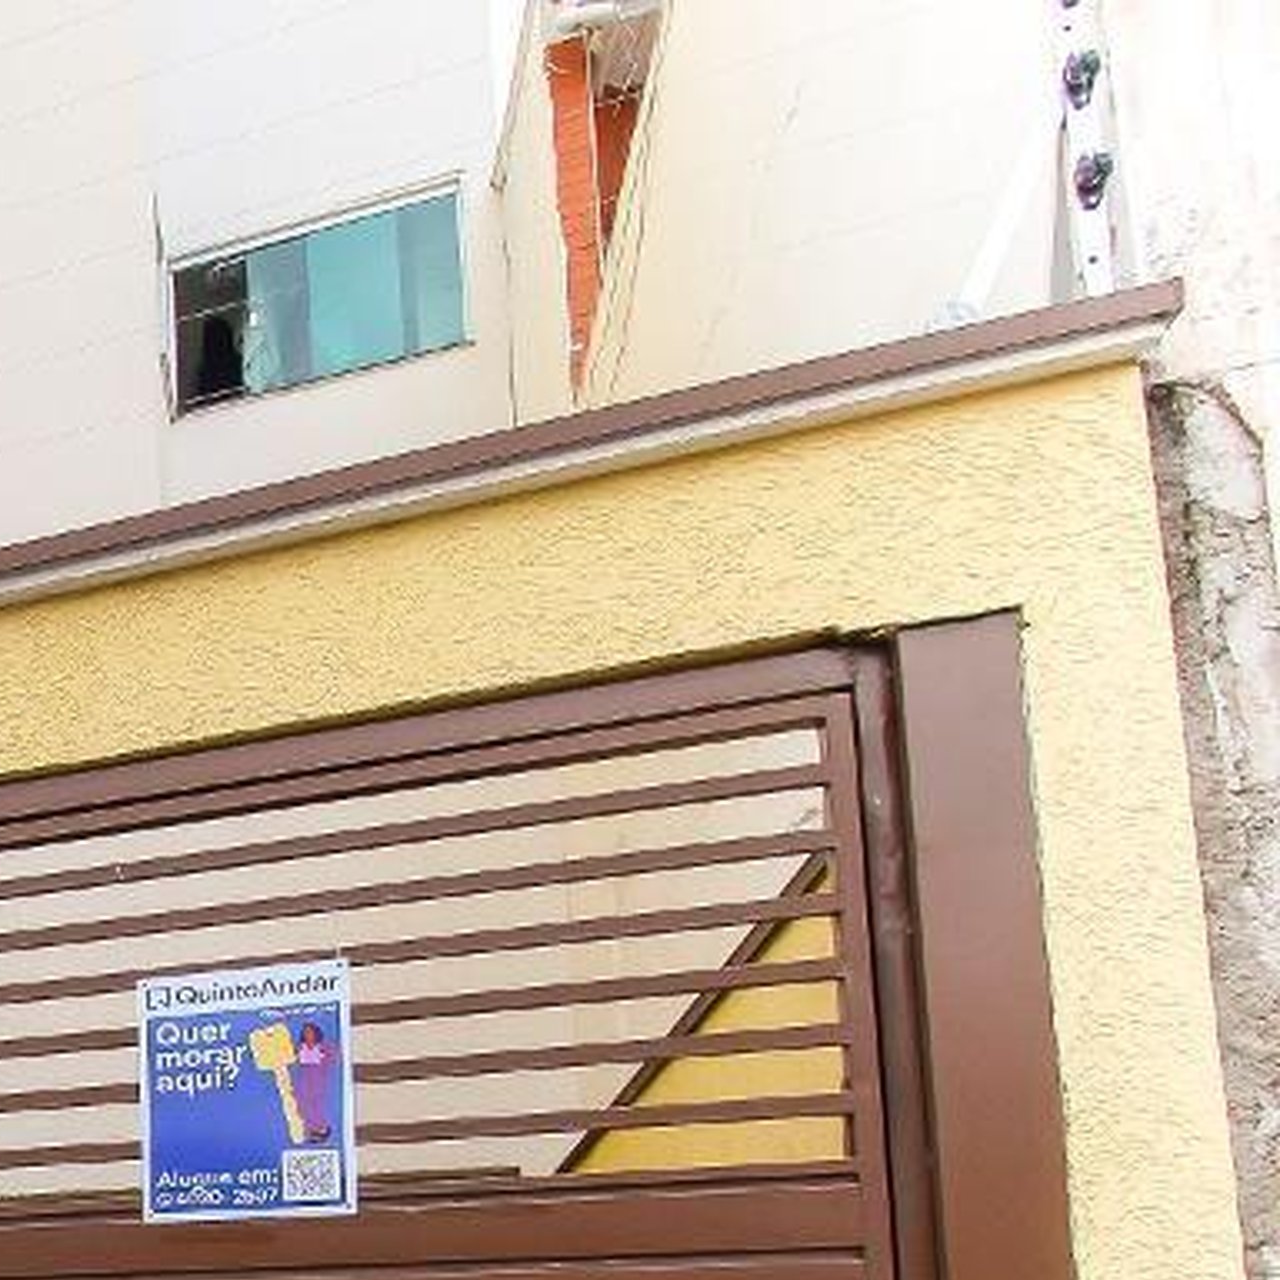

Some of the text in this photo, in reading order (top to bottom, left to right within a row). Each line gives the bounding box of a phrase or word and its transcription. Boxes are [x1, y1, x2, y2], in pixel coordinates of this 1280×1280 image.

[176, 976, 339, 1004] QuintoAndar
[156, 1022, 231, 1045] Quer
[156, 1044, 248, 1071] morar
[156, 1066, 239, 1096] aqui?
[238, 1169, 278, 1184] em:
